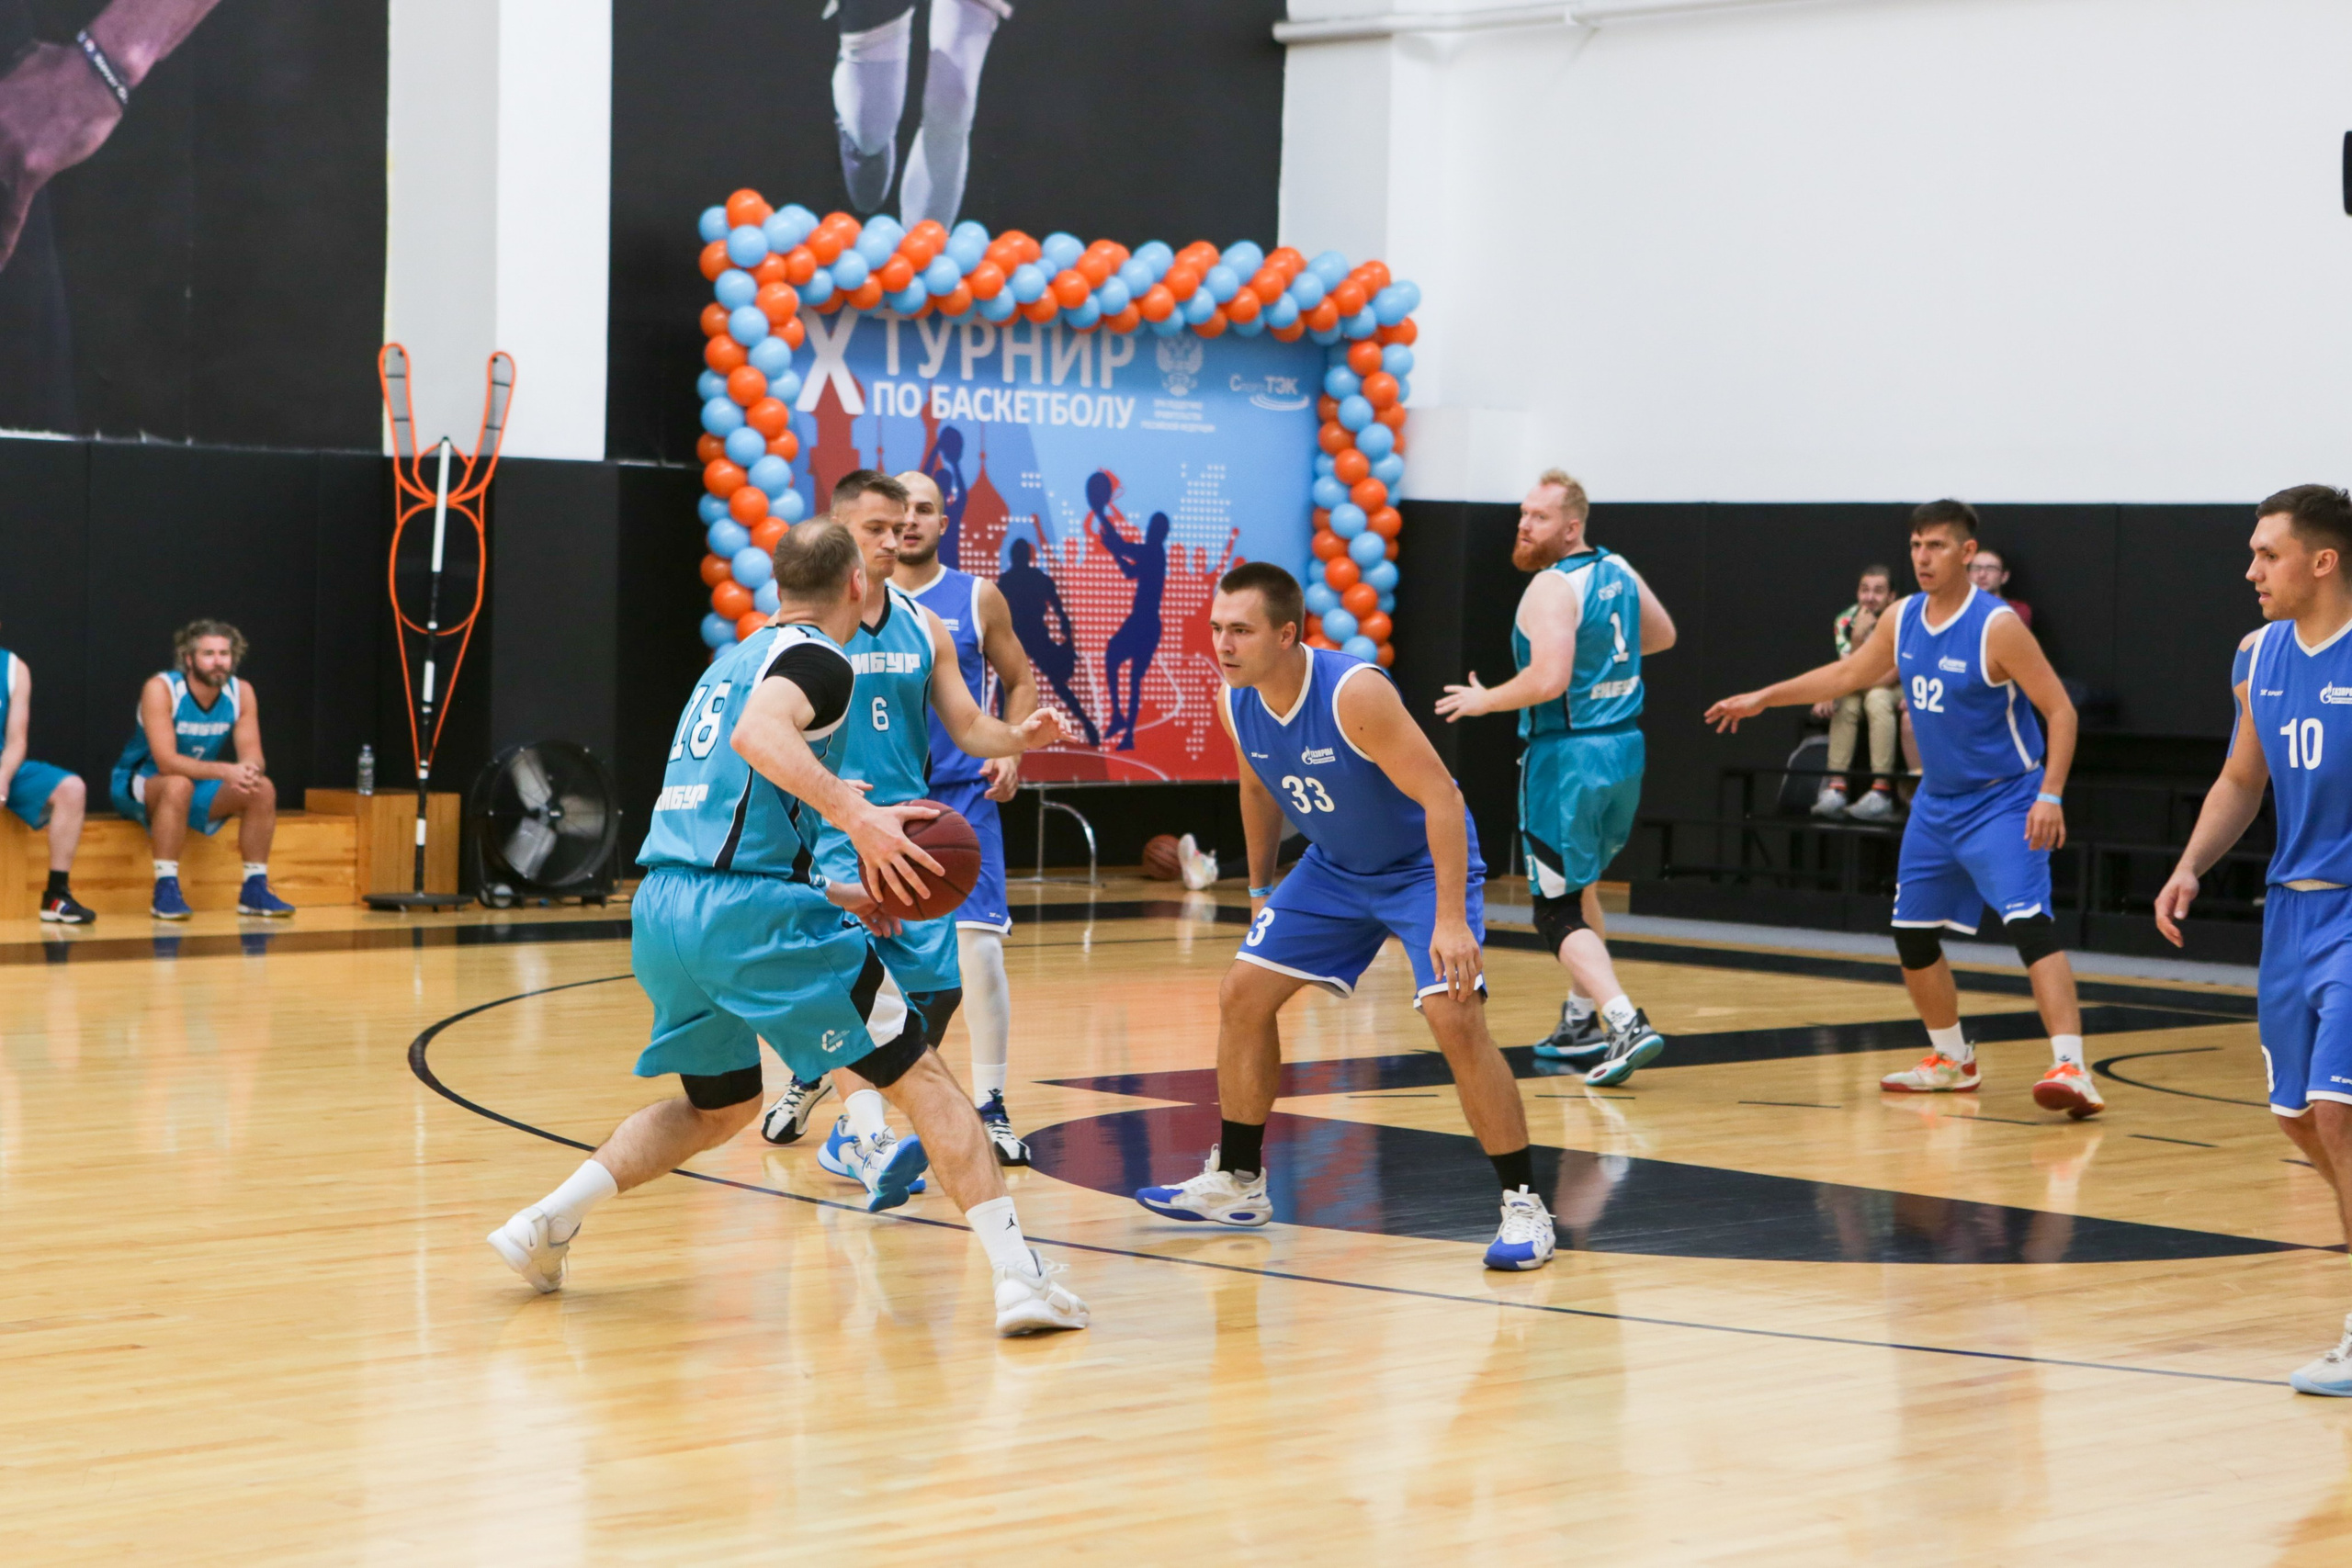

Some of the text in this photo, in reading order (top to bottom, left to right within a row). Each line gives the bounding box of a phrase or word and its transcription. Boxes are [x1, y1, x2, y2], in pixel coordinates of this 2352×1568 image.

[873, 309, 1136, 389] ТУРНИР
[873, 381, 1136, 429] ПО БАСКЕТБОЛУ
[1610, 612, 1630, 664] 1
[851, 652, 921, 675] ИБУР
[871, 695, 890, 732] 6
[1911, 675, 1945, 713] 92
[668, 680, 732, 762] 18
[2279, 717, 2324, 770] 10
[1282, 775, 1335, 814] 33
[1245, 907, 1275, 947] 3
